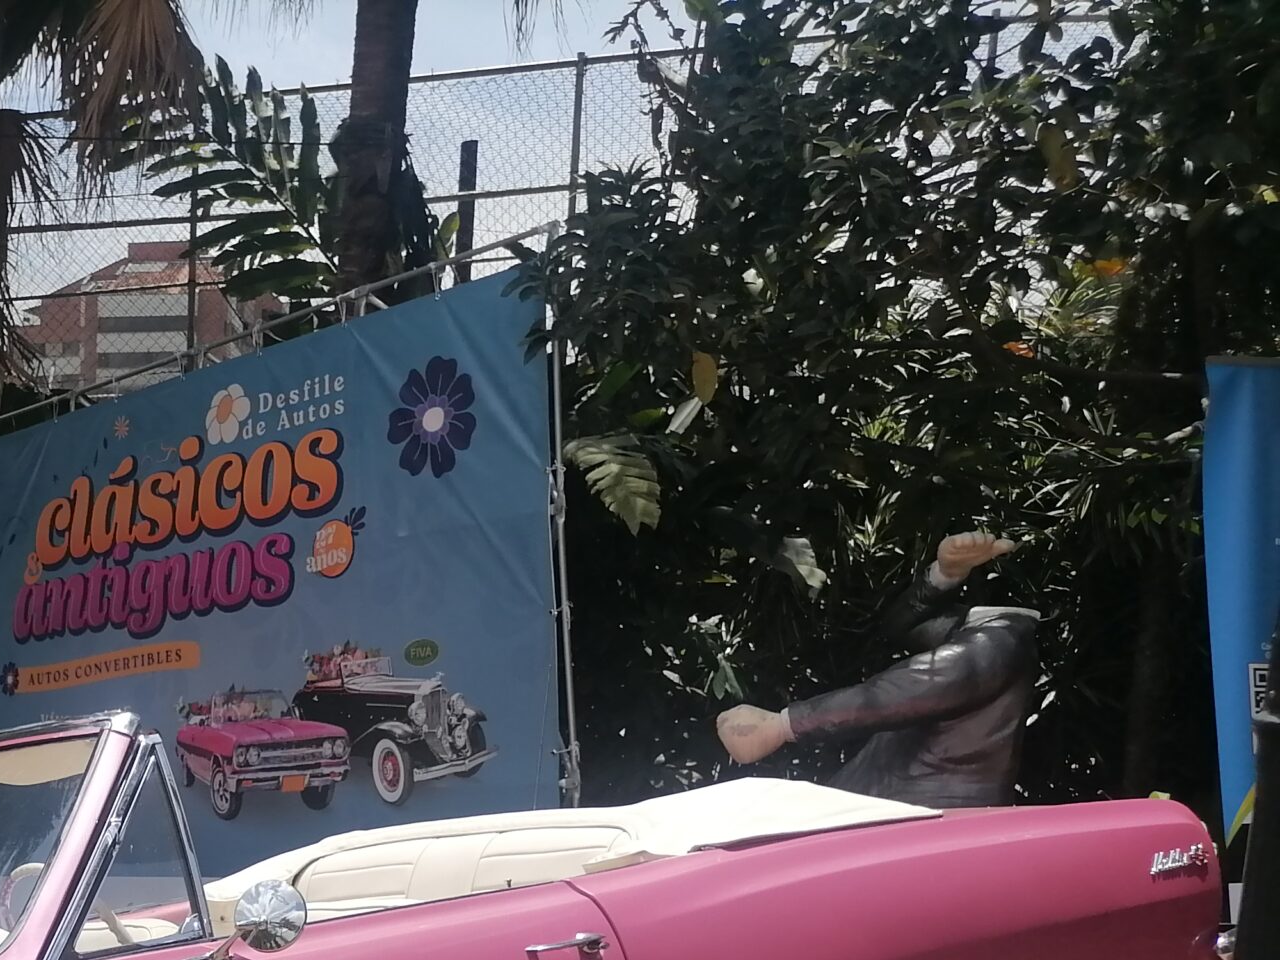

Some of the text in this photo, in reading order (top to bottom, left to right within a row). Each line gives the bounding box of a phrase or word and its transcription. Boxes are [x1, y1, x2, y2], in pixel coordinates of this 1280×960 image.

[258, 373, 345, 414] Desfile
[242, 399, 345, 440] de Autos
[35, 428, 342, 567] clásicos
[305, 546, 348, 574] años
[12, 532, 293, 642] antiguos
[27, 648, 183, 687] AUTOS CONVERTIBLES
[410, 645, 433, 660] FIVA
